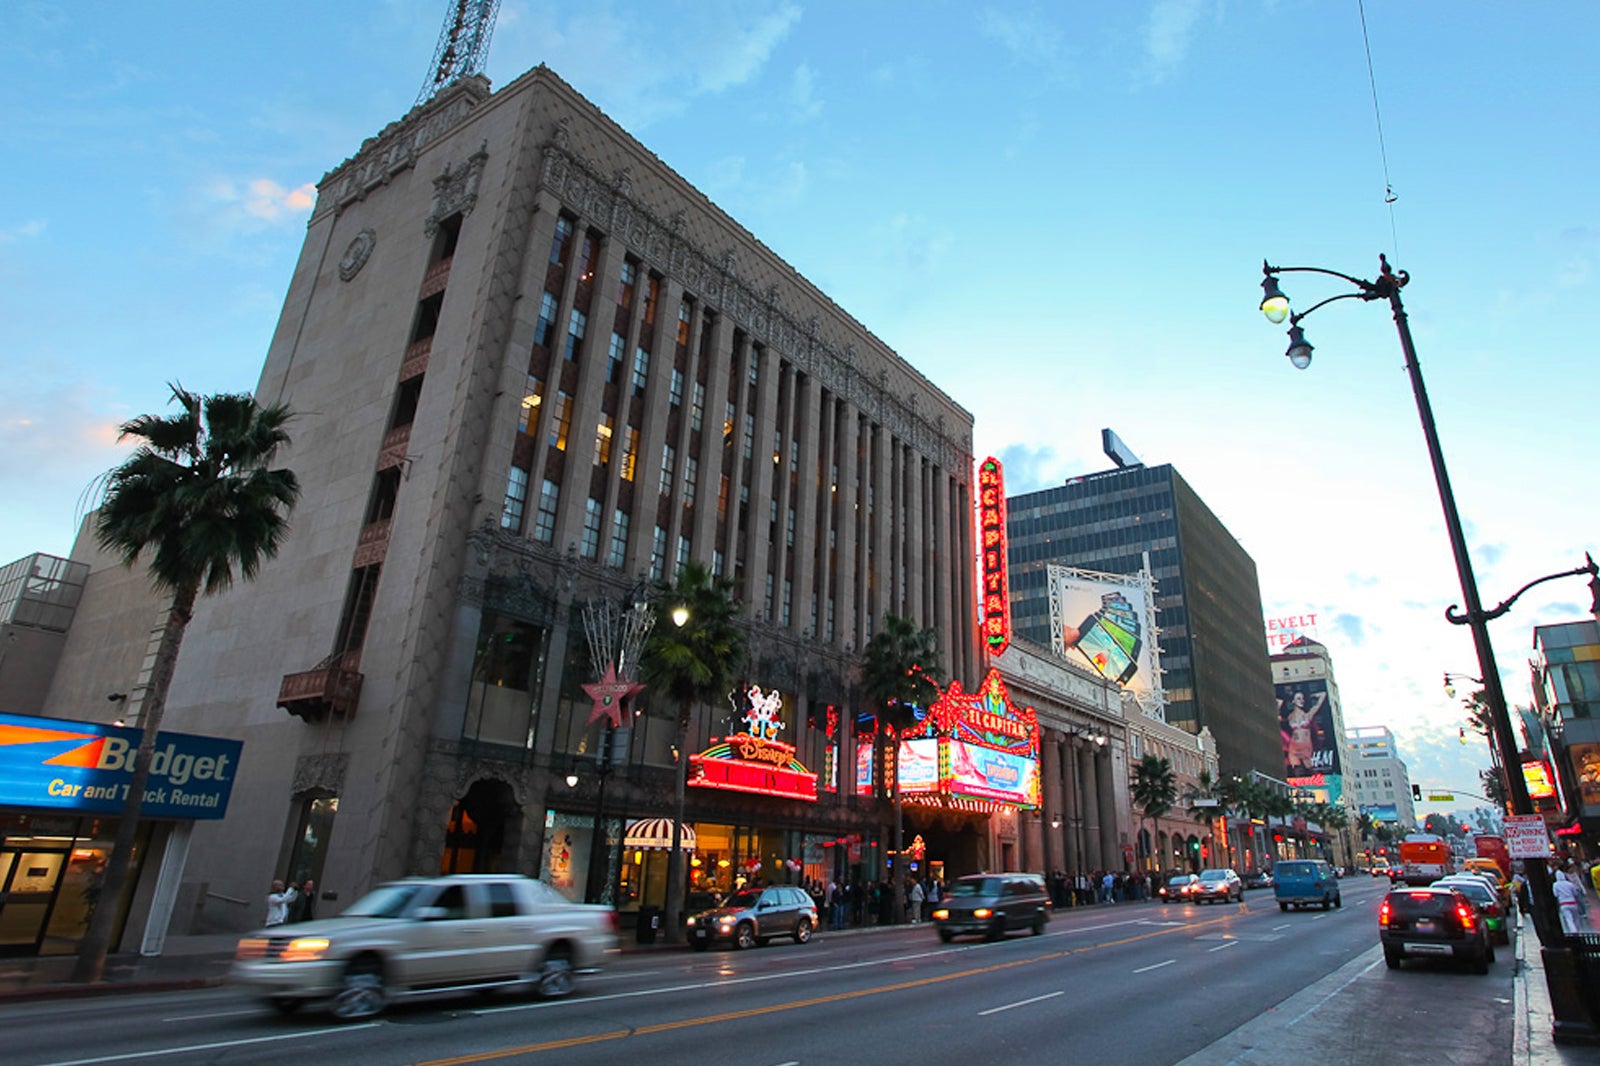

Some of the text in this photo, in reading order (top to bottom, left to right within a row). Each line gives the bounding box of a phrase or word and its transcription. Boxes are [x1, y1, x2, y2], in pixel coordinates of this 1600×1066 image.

[980, 470, 1003, 635] EL CAPITAN
[969, 709, 1025, 738] EL CAPITAN
[47, 779, 219, 808] Car and Tck Rental
